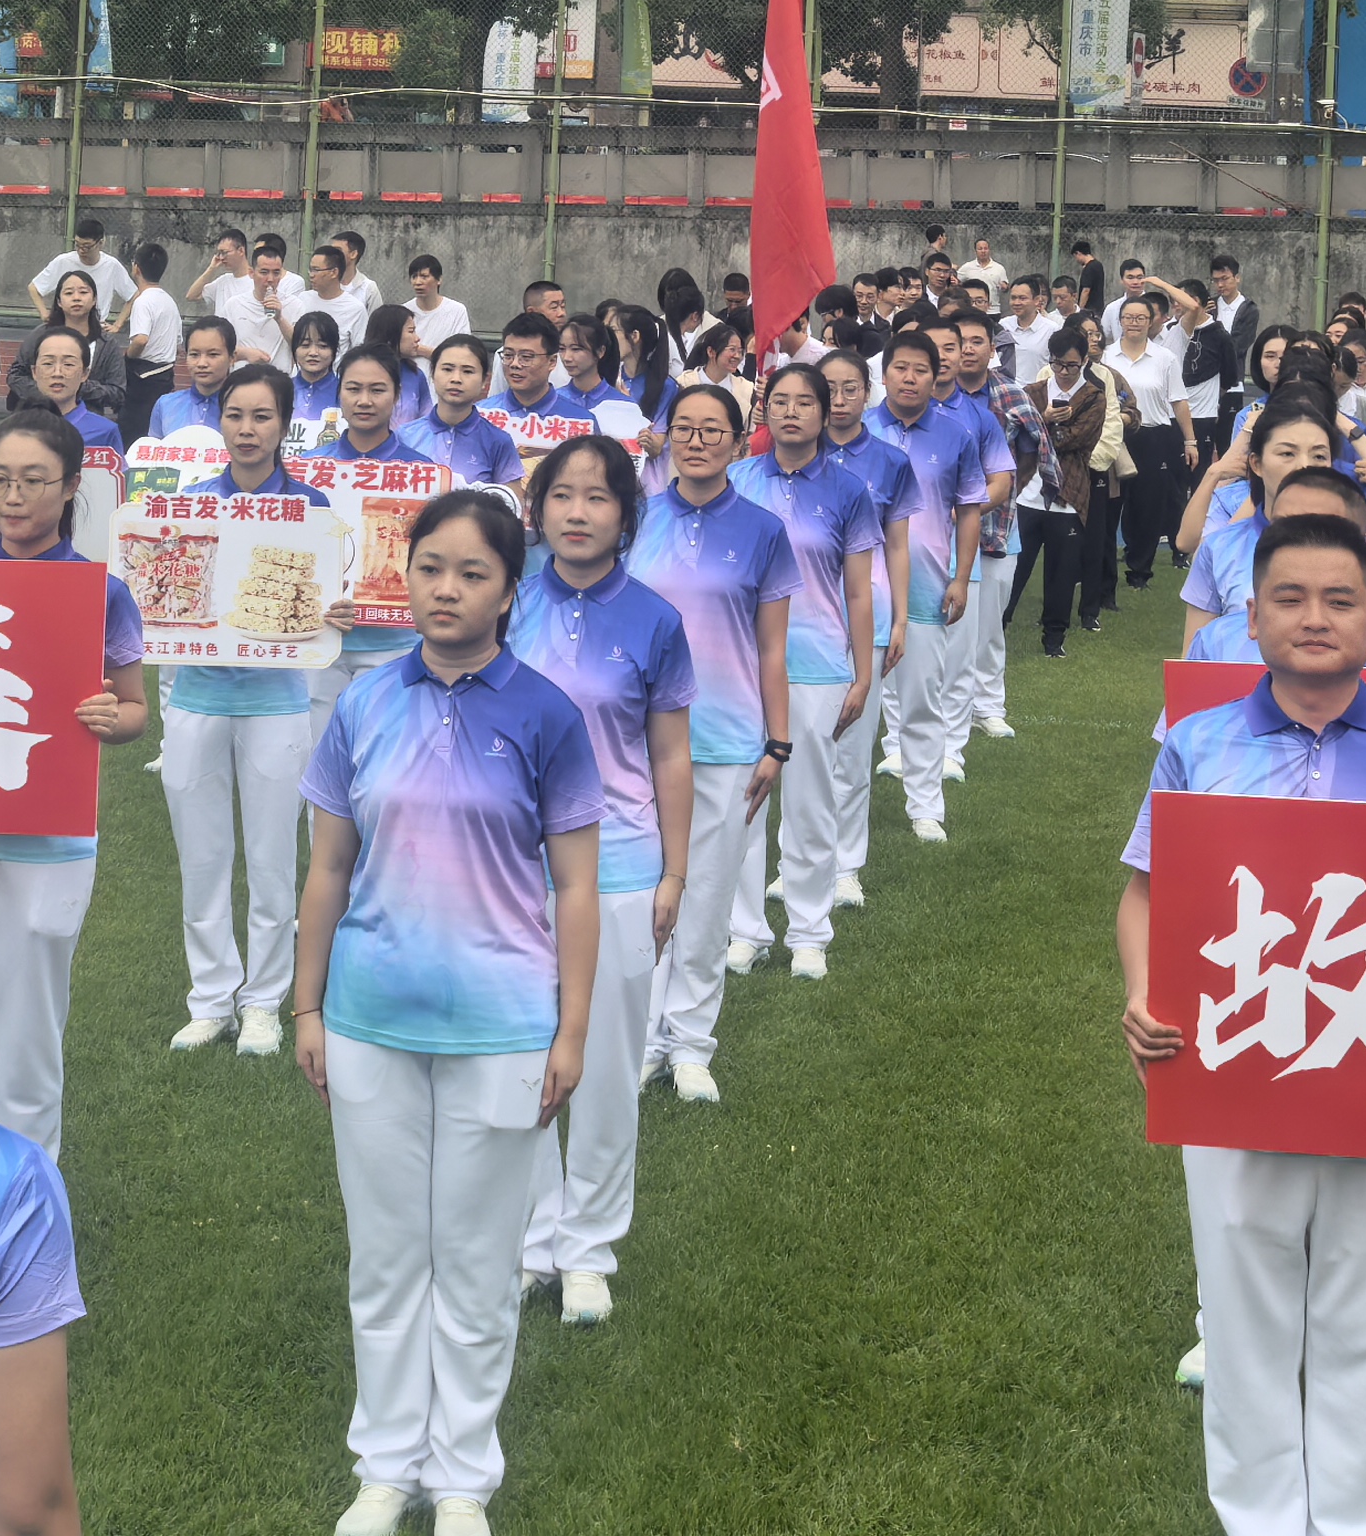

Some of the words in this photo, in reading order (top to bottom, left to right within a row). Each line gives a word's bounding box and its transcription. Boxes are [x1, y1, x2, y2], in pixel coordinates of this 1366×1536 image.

[480, 411, 591, 441] 发·小米酥
[144, 494, 306, 523] 渝吉发·米花糖
[237, 644, 299, 659] 匠心手艺
